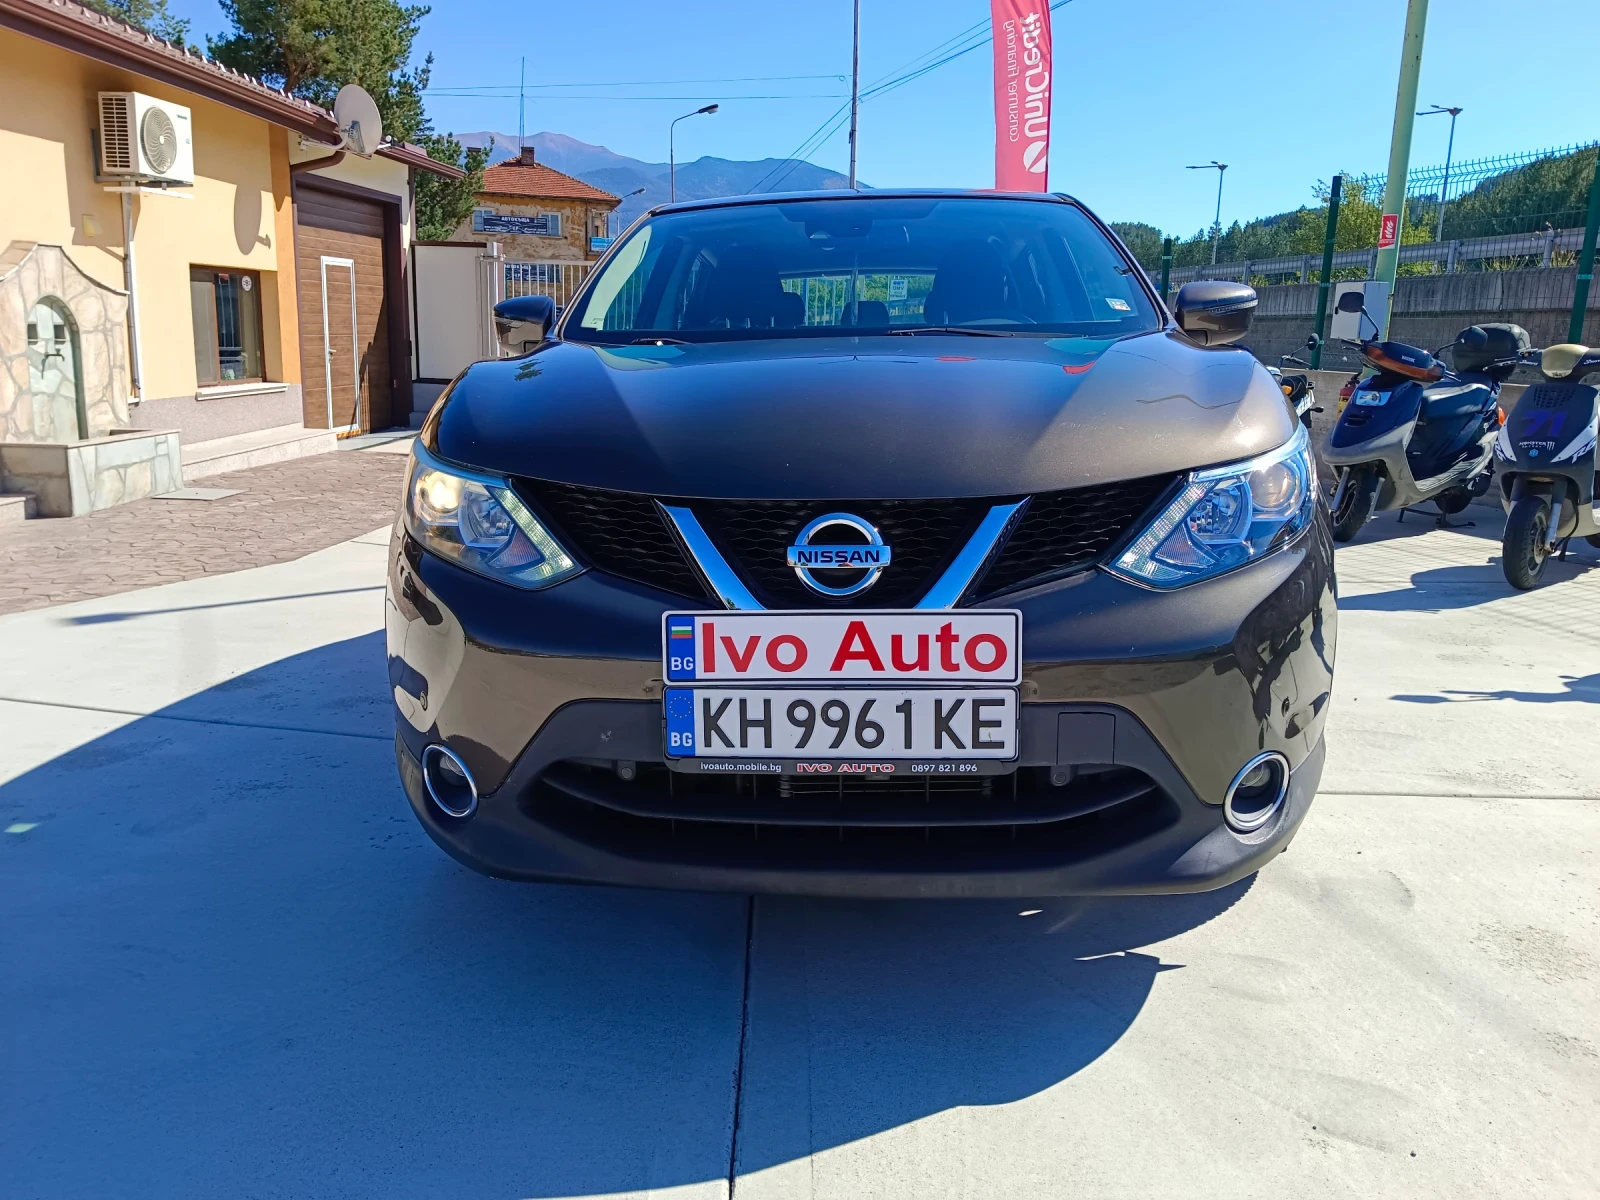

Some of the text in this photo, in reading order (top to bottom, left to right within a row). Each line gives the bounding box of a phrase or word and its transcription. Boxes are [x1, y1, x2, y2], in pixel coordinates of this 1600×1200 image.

[1524, 410, 1568, 437] 71
[797, 550, 880, 563] NISSAN
[702, 620, 1008, 673] Ivo Auto
[671, 657, 694, 671] BG
[703, 698, 1005, 749] KH 9961 KE
[670, 732, 693, 747] BG
[700, 762, 978, 773] ivoauto.mobile.bg IVO AUTO 0897 821 896
